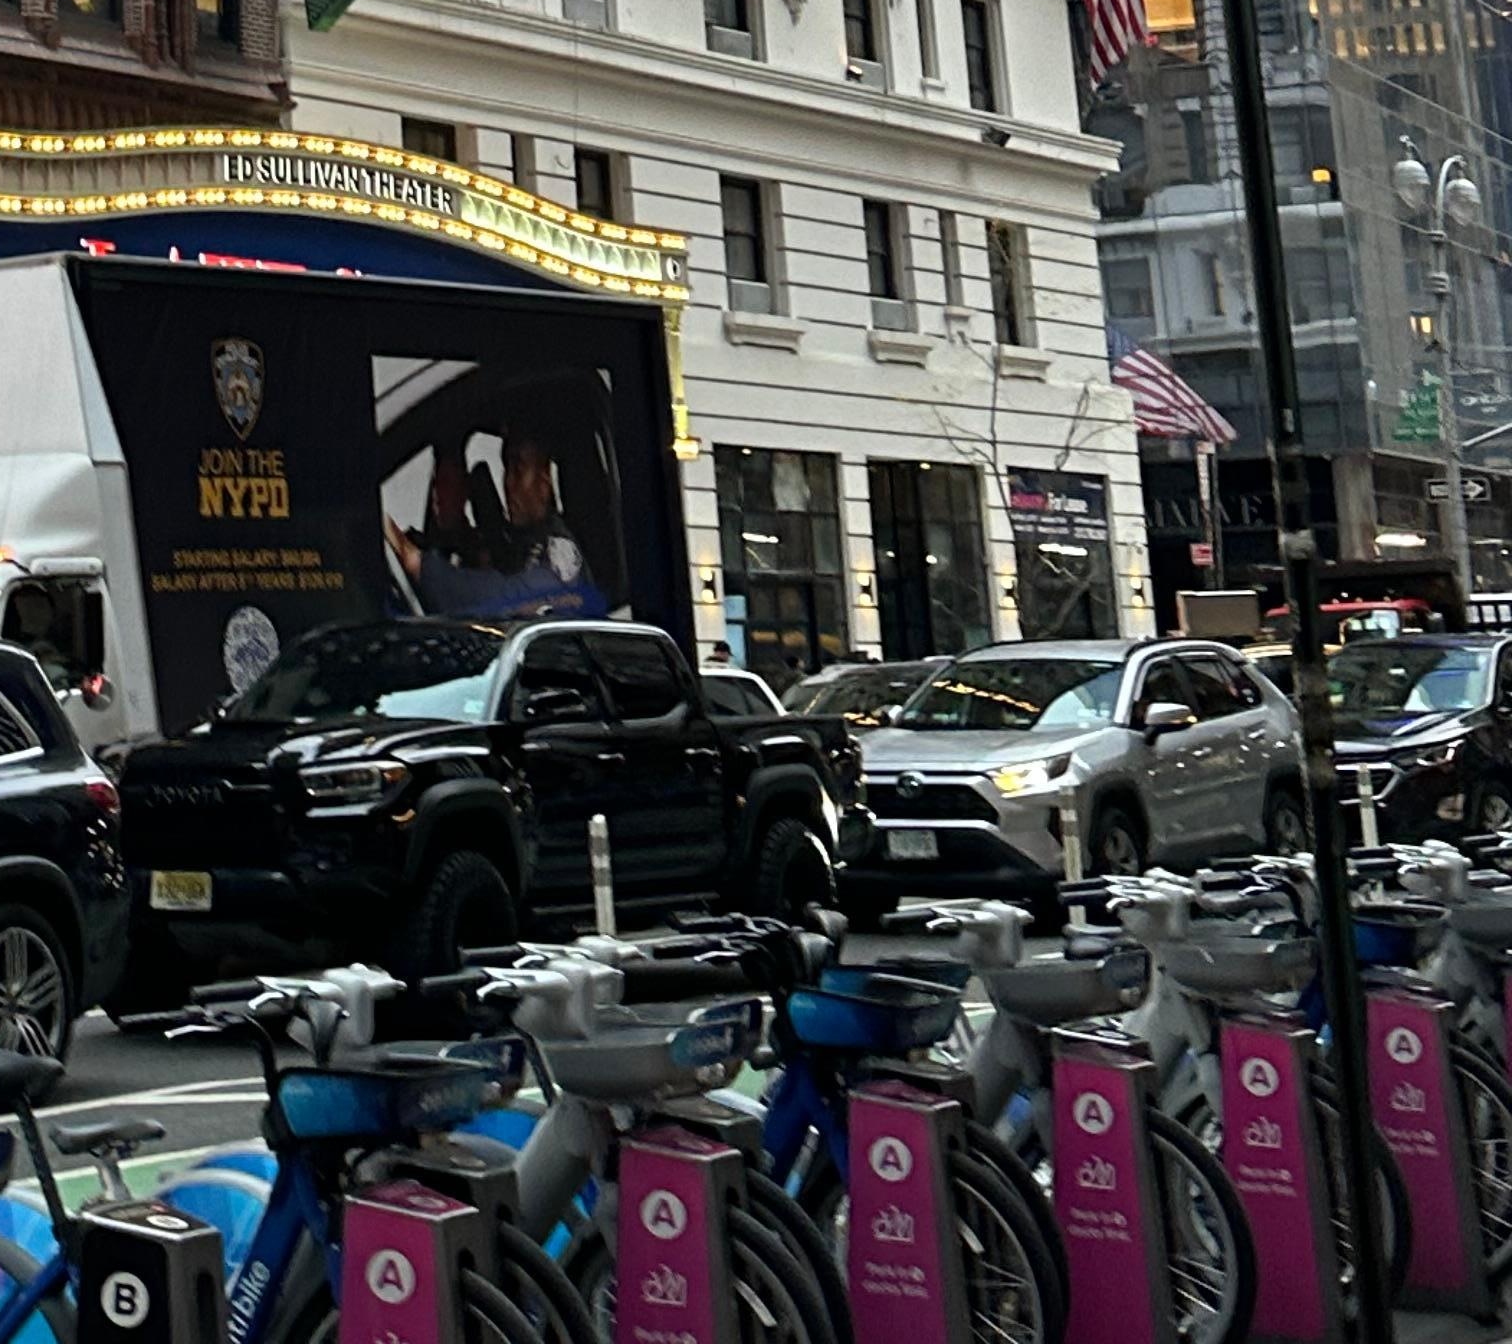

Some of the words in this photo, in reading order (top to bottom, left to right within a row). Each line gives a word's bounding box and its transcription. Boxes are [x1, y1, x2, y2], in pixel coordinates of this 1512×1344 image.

[223, 154, 253, 182] ED
[256, 155, 361, 194] SULLIVAN
[360, 167, 455, 216] THEATER
[198, 447, 243, 475] JOIN
[245, 448, 286, 477] THE
[199, 476, 290, 518] NYPD
[114, 1281, 138, 1316] B
